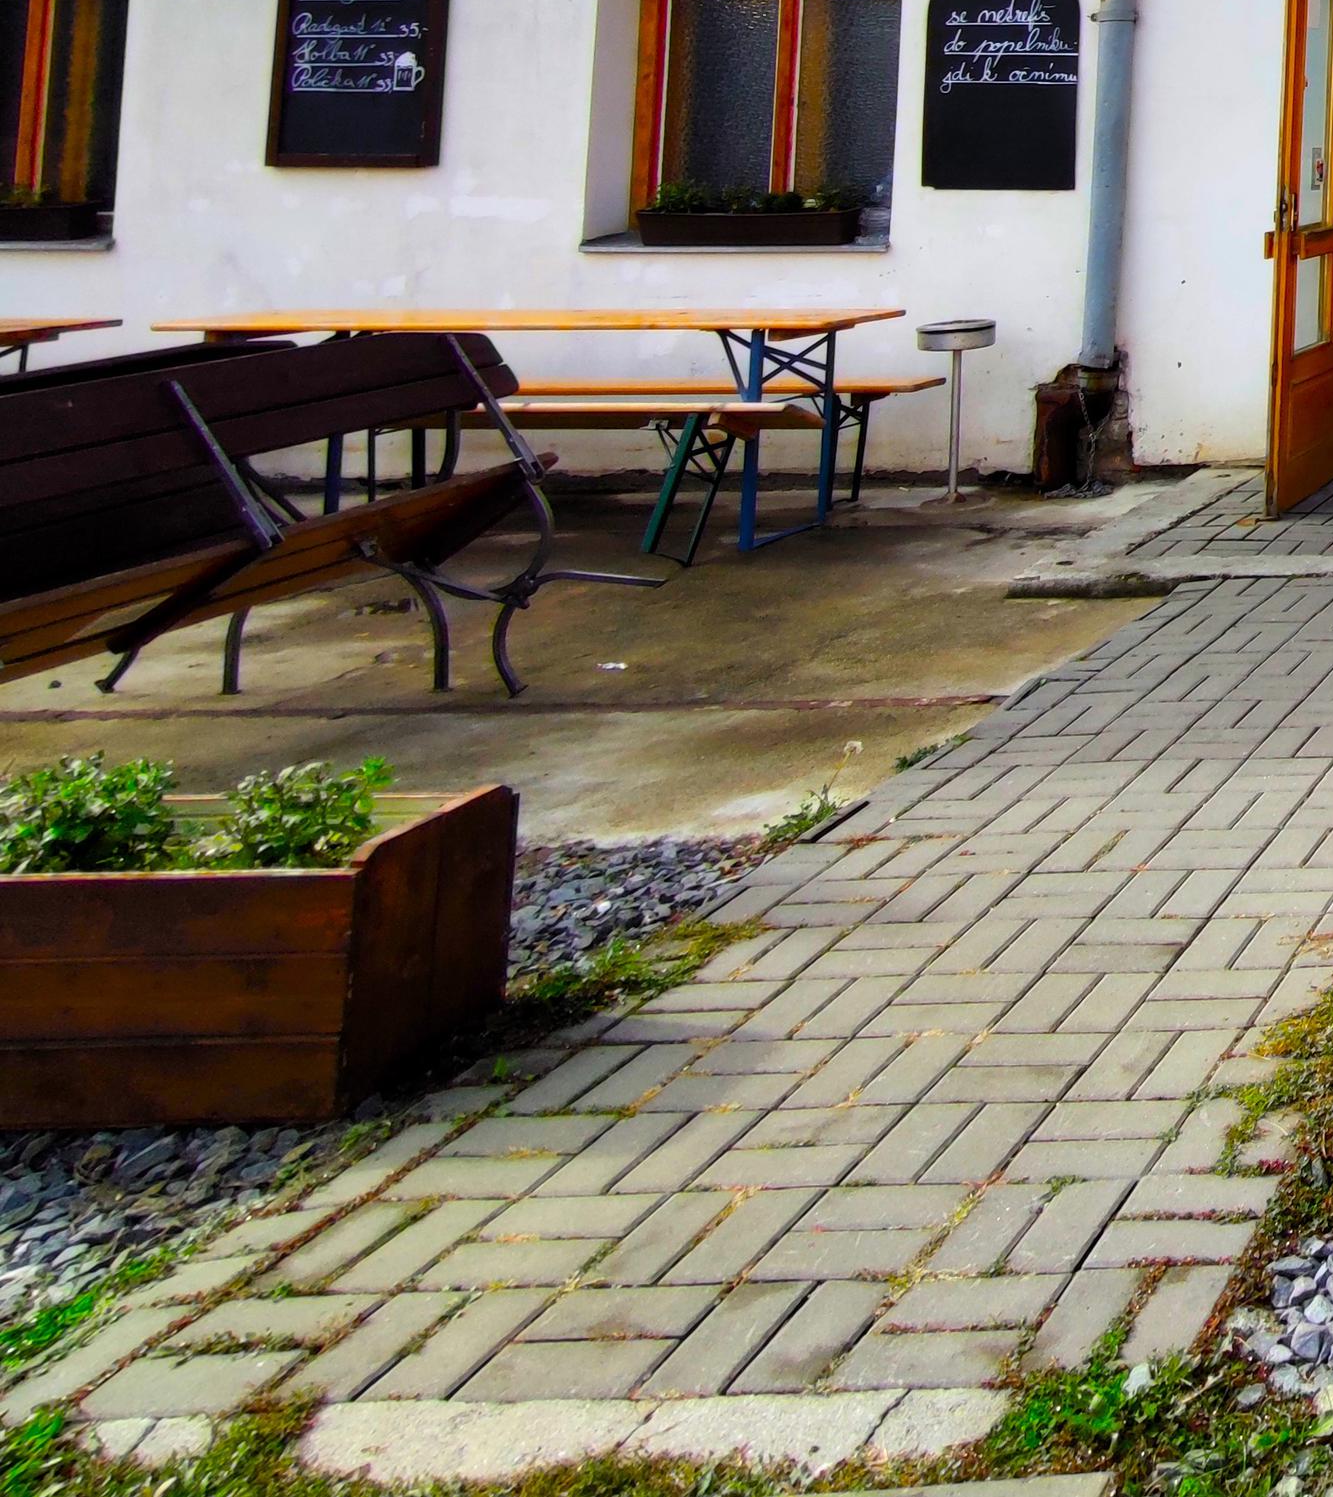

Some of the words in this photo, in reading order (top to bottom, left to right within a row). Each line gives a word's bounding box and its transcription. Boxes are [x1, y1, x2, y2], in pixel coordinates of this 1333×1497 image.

[945, 11, 968, 24] se
[944, 29, 967, 52] do
[940, 62, 973, 93] jdi
